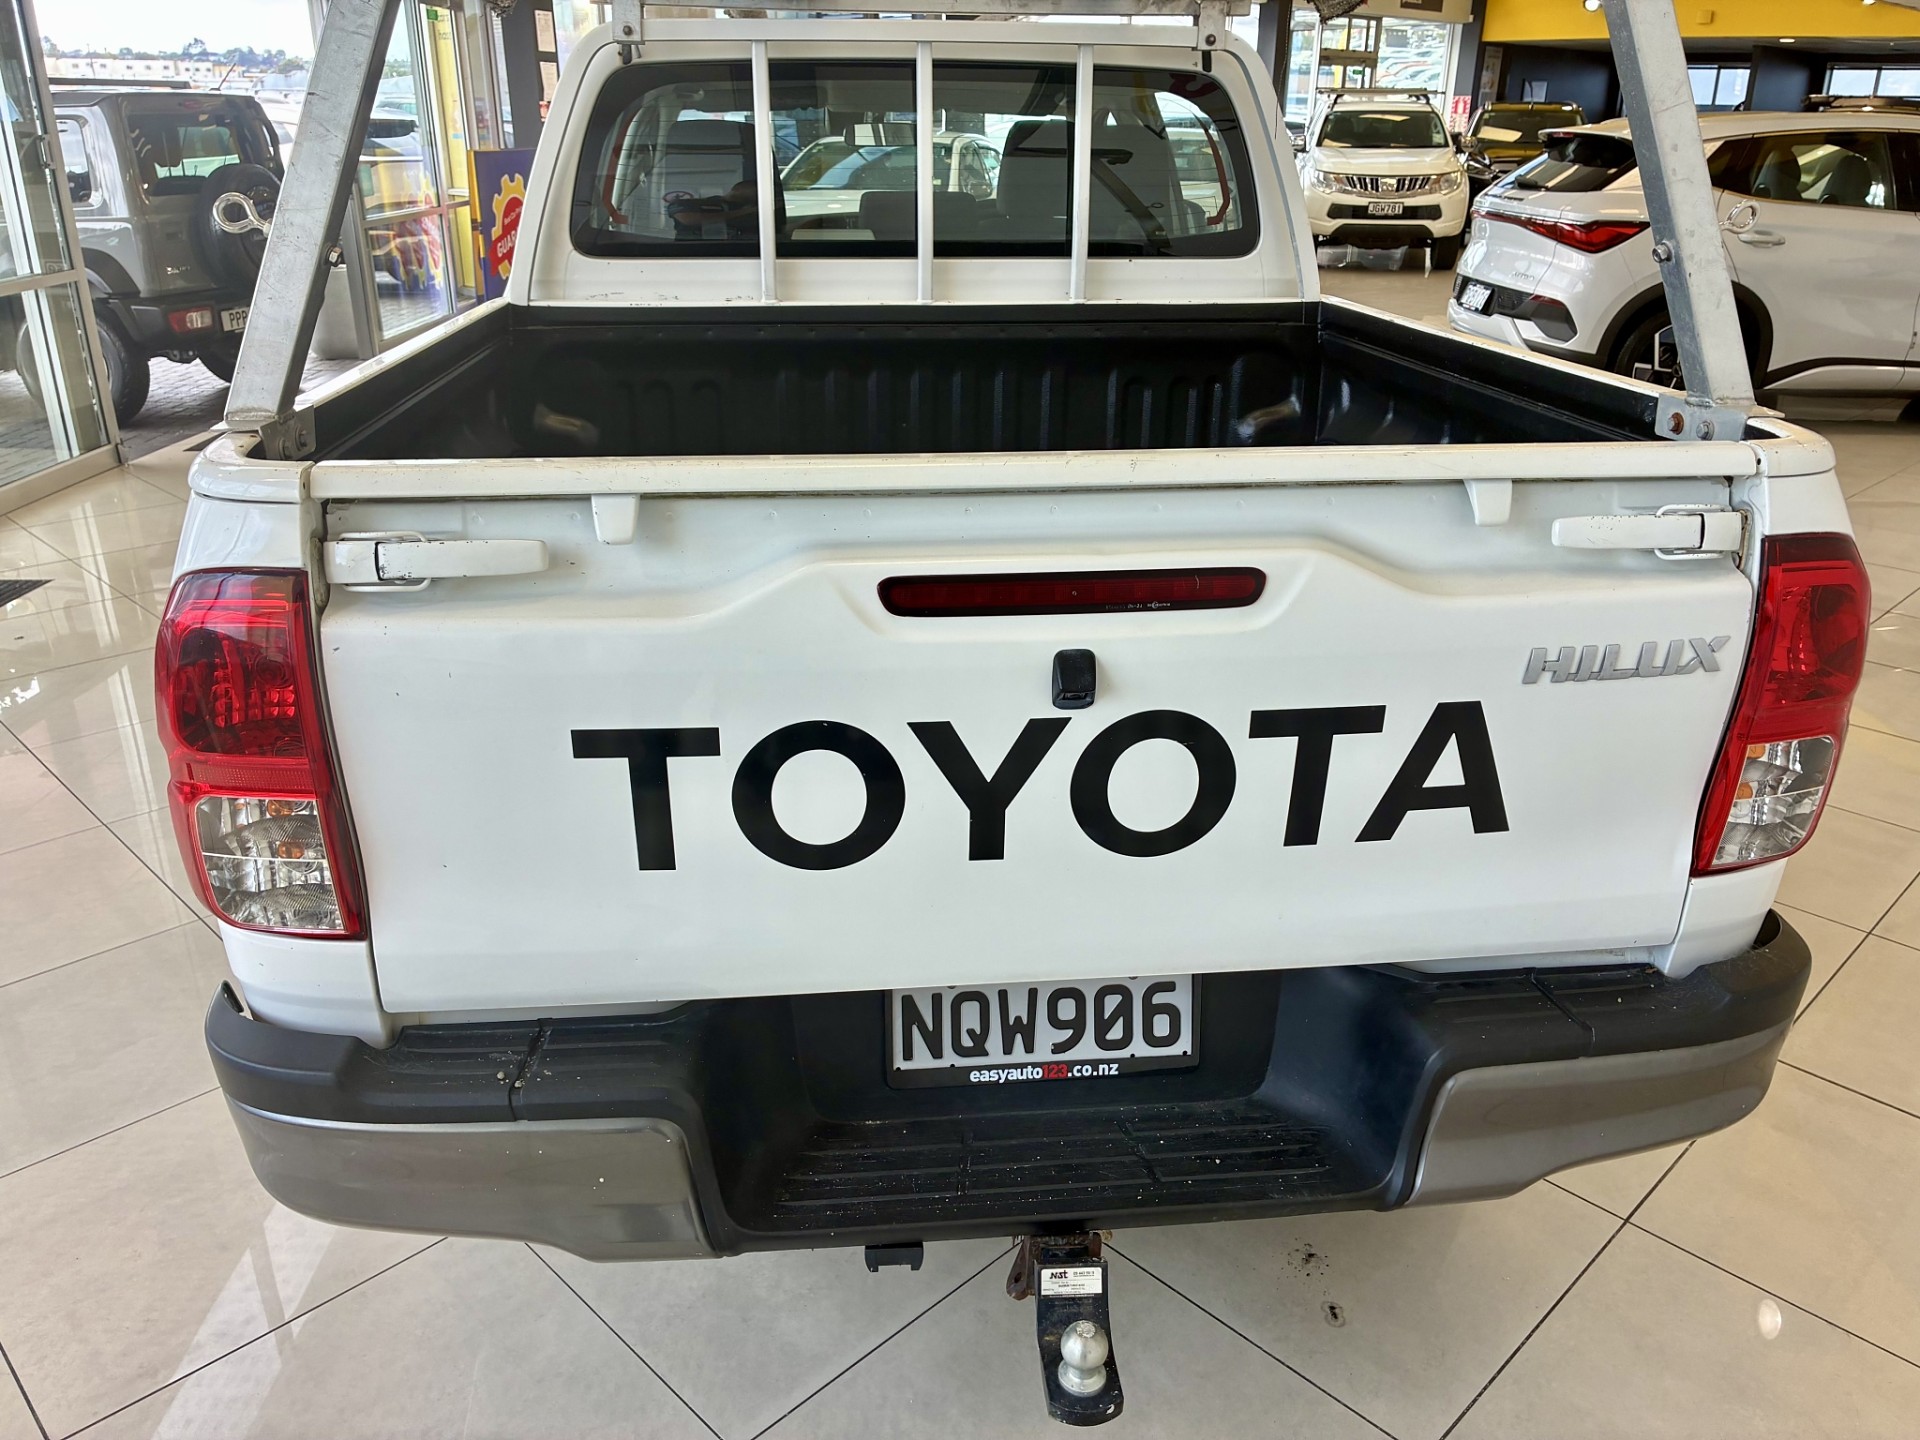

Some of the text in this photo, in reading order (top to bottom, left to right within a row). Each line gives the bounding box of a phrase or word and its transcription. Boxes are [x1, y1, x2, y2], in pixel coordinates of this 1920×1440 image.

[1369, 203, 1401, 213] JGW781
[1522, 635, 1731, 684] HILUX
[570, 700, 1510, 871] TOYOTA
[901, 980, 1182, 1061] NQW906
[969, 1063, 1119, 1084] easyauto123.co.nz
